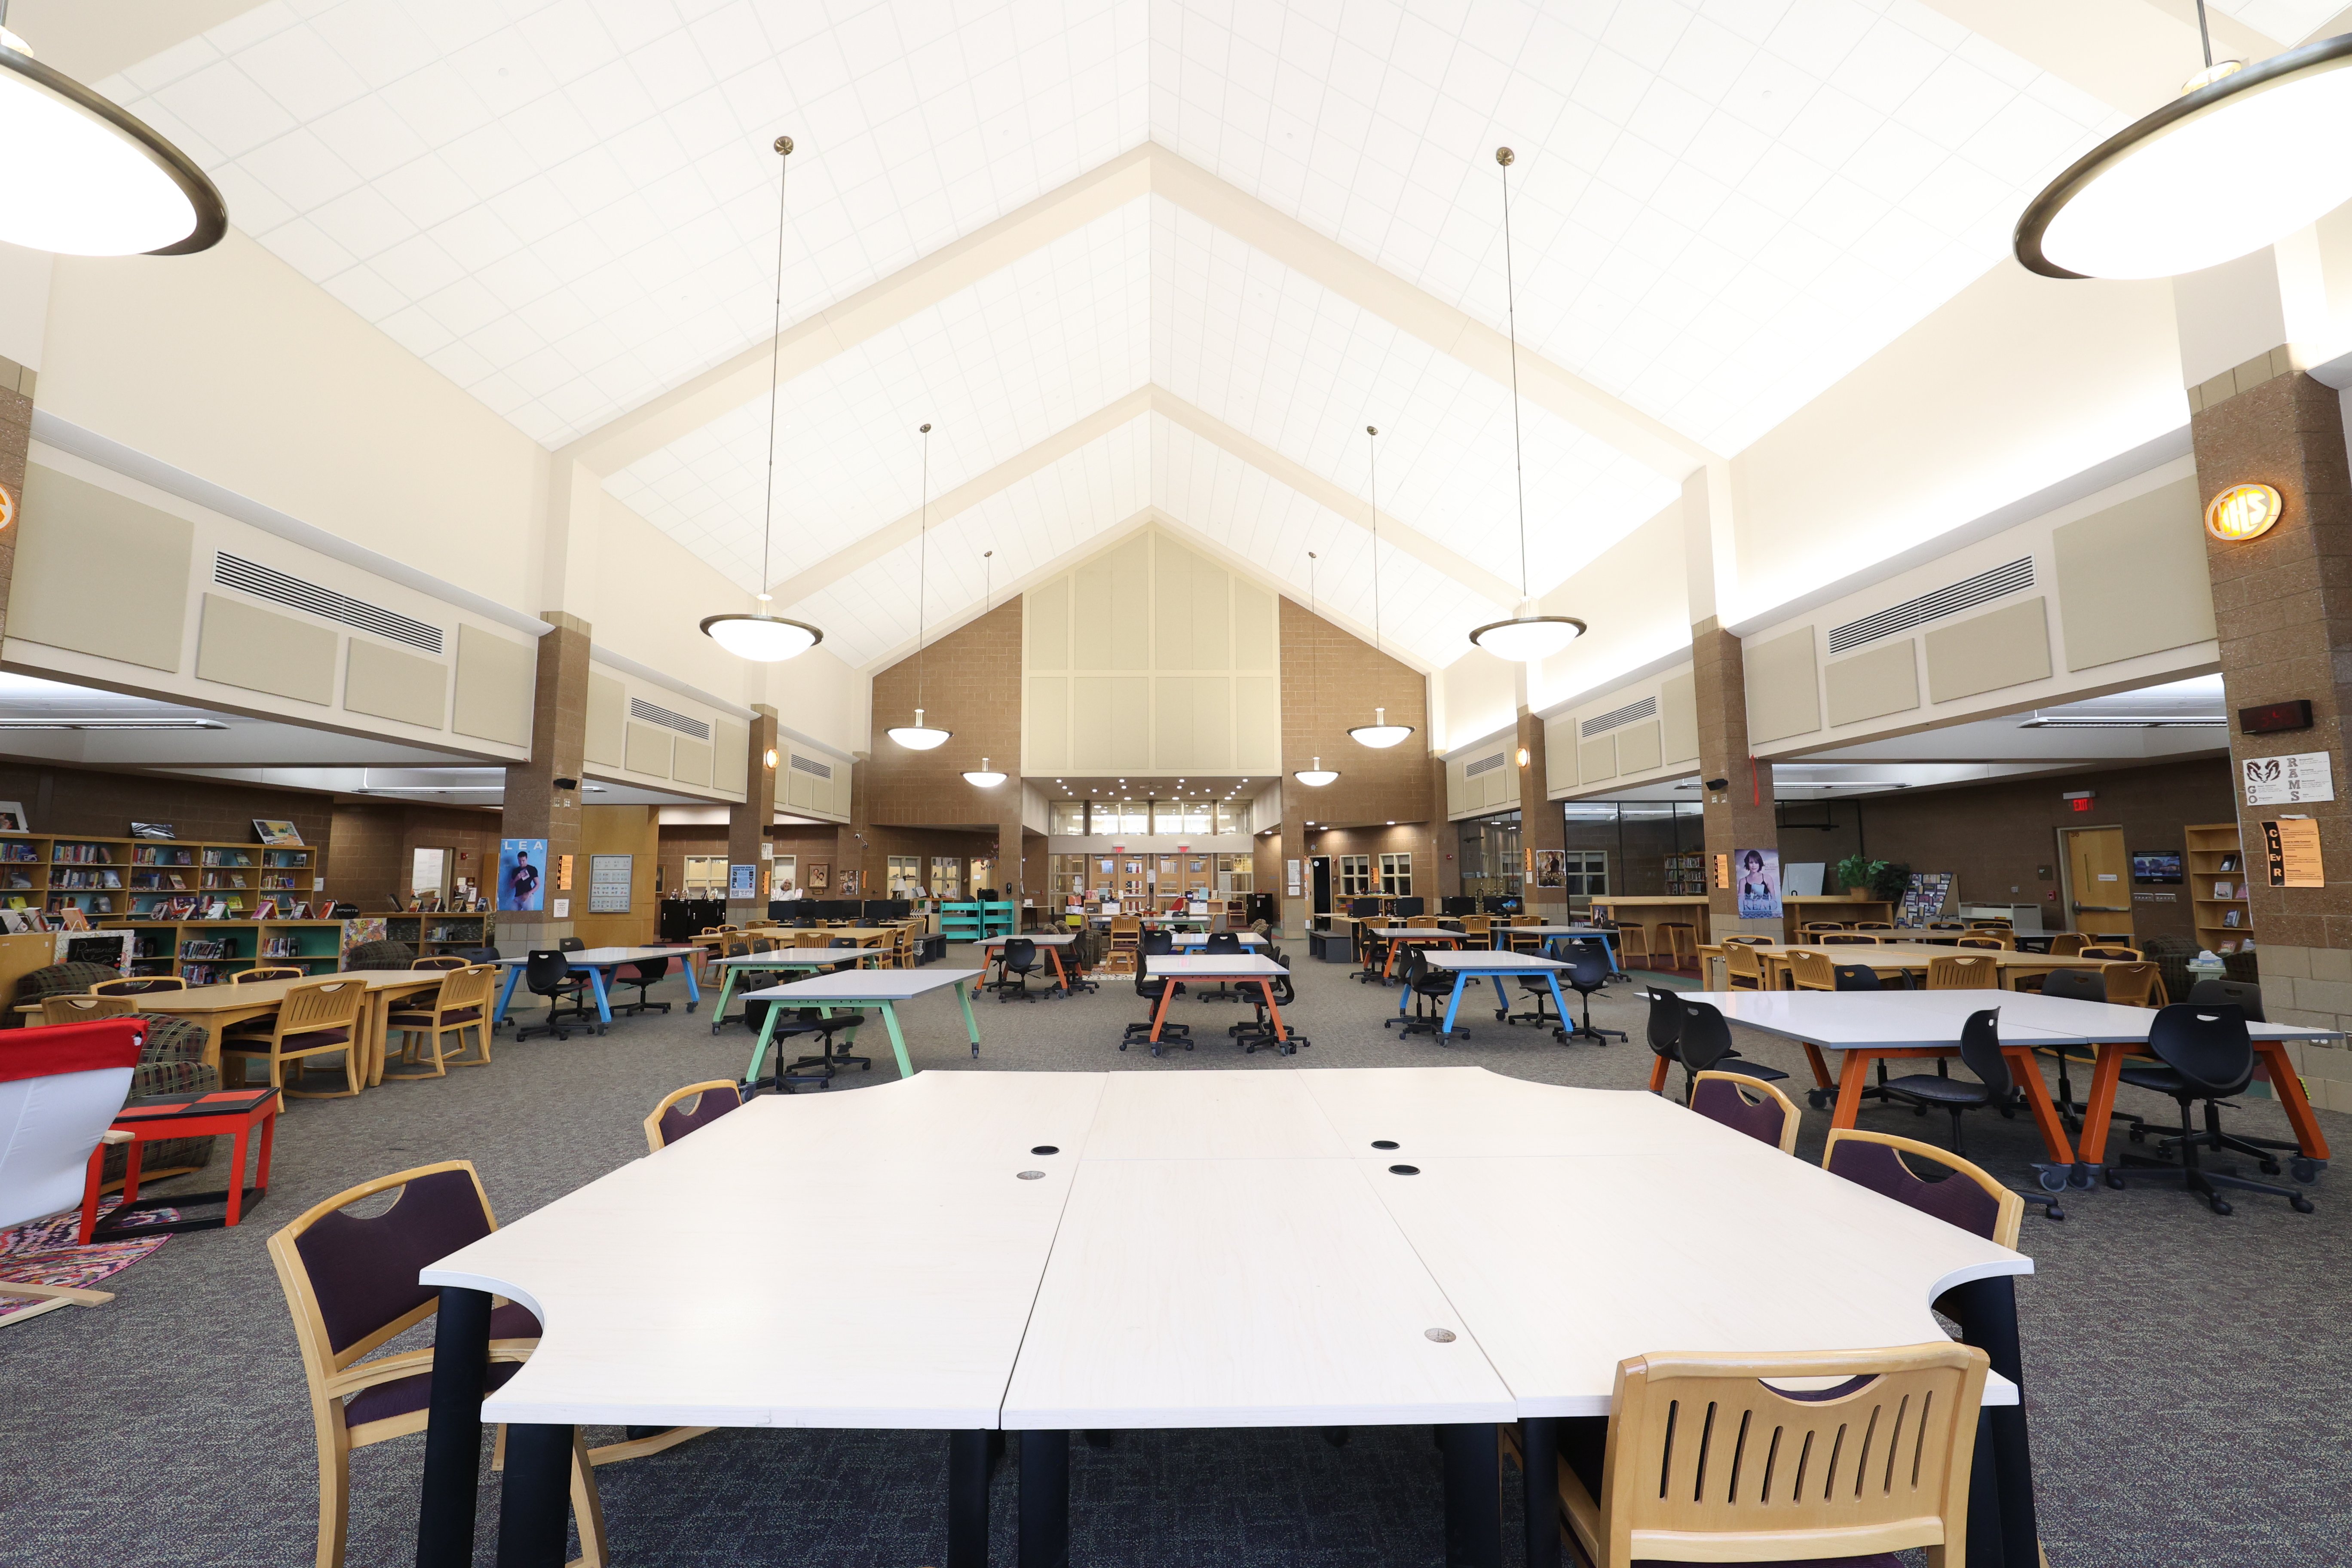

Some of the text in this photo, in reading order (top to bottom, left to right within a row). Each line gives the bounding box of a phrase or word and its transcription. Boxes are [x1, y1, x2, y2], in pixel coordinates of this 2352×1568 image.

[2287, 758, 2300, 801] RAMS
[2248, 785, 2257, 803] GO
[2073, 799, 2088, 811] EXIT
[505, 841, 542, 850] LEA
[1743, 900, 1777, 910] READ
[74, 941, 120, 961] Romance
